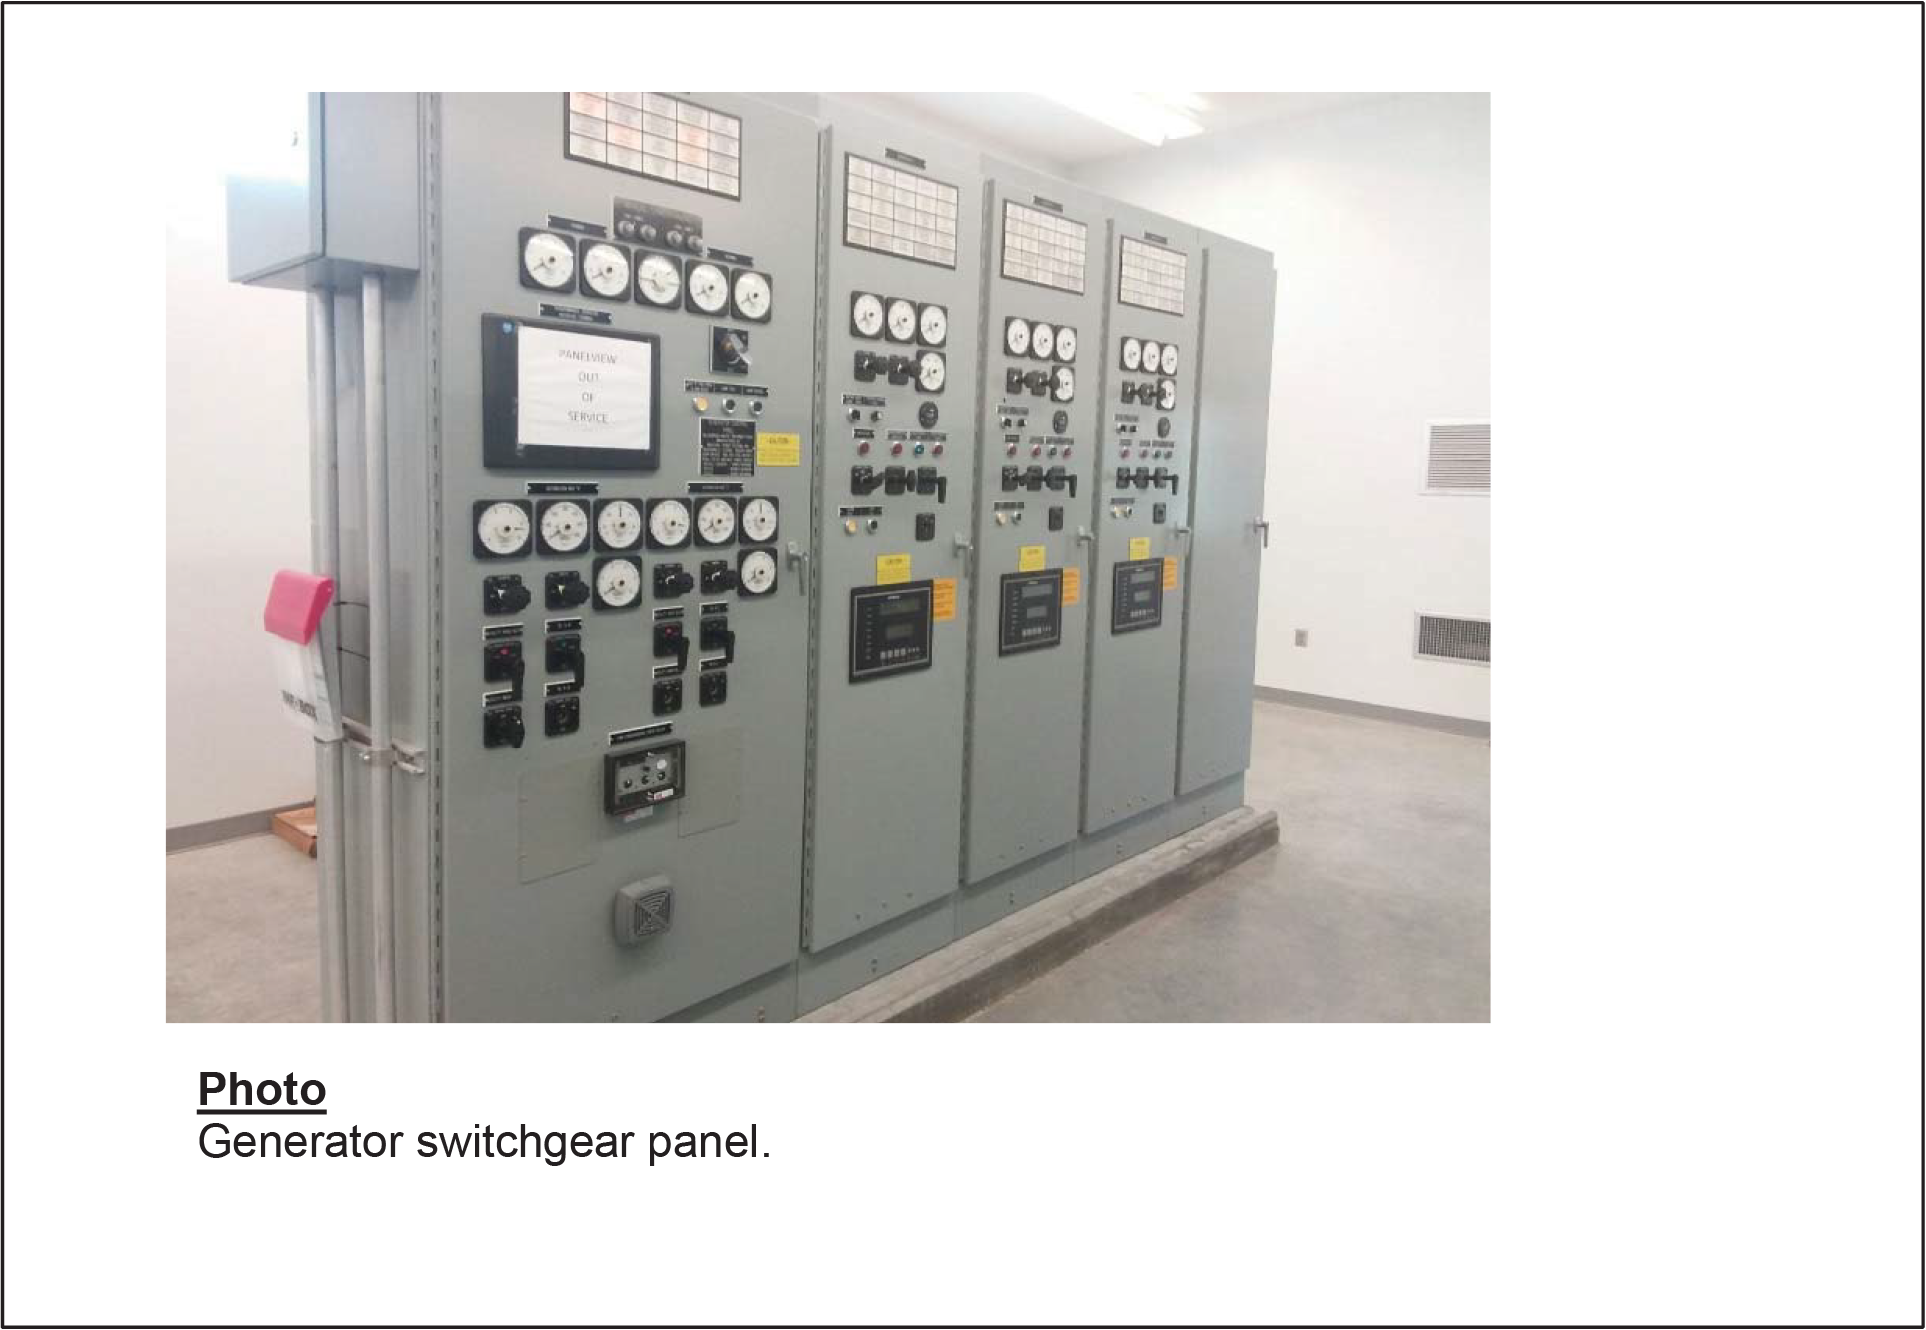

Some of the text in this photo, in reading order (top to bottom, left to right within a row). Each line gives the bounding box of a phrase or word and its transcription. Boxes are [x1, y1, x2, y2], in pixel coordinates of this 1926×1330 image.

[559, 349, 618, 364] PANELVIEW
[578, 371, 599, 383] OUT
[581, 391, 594, 403] OF
[567, 410, 609, 424] SERVICE
